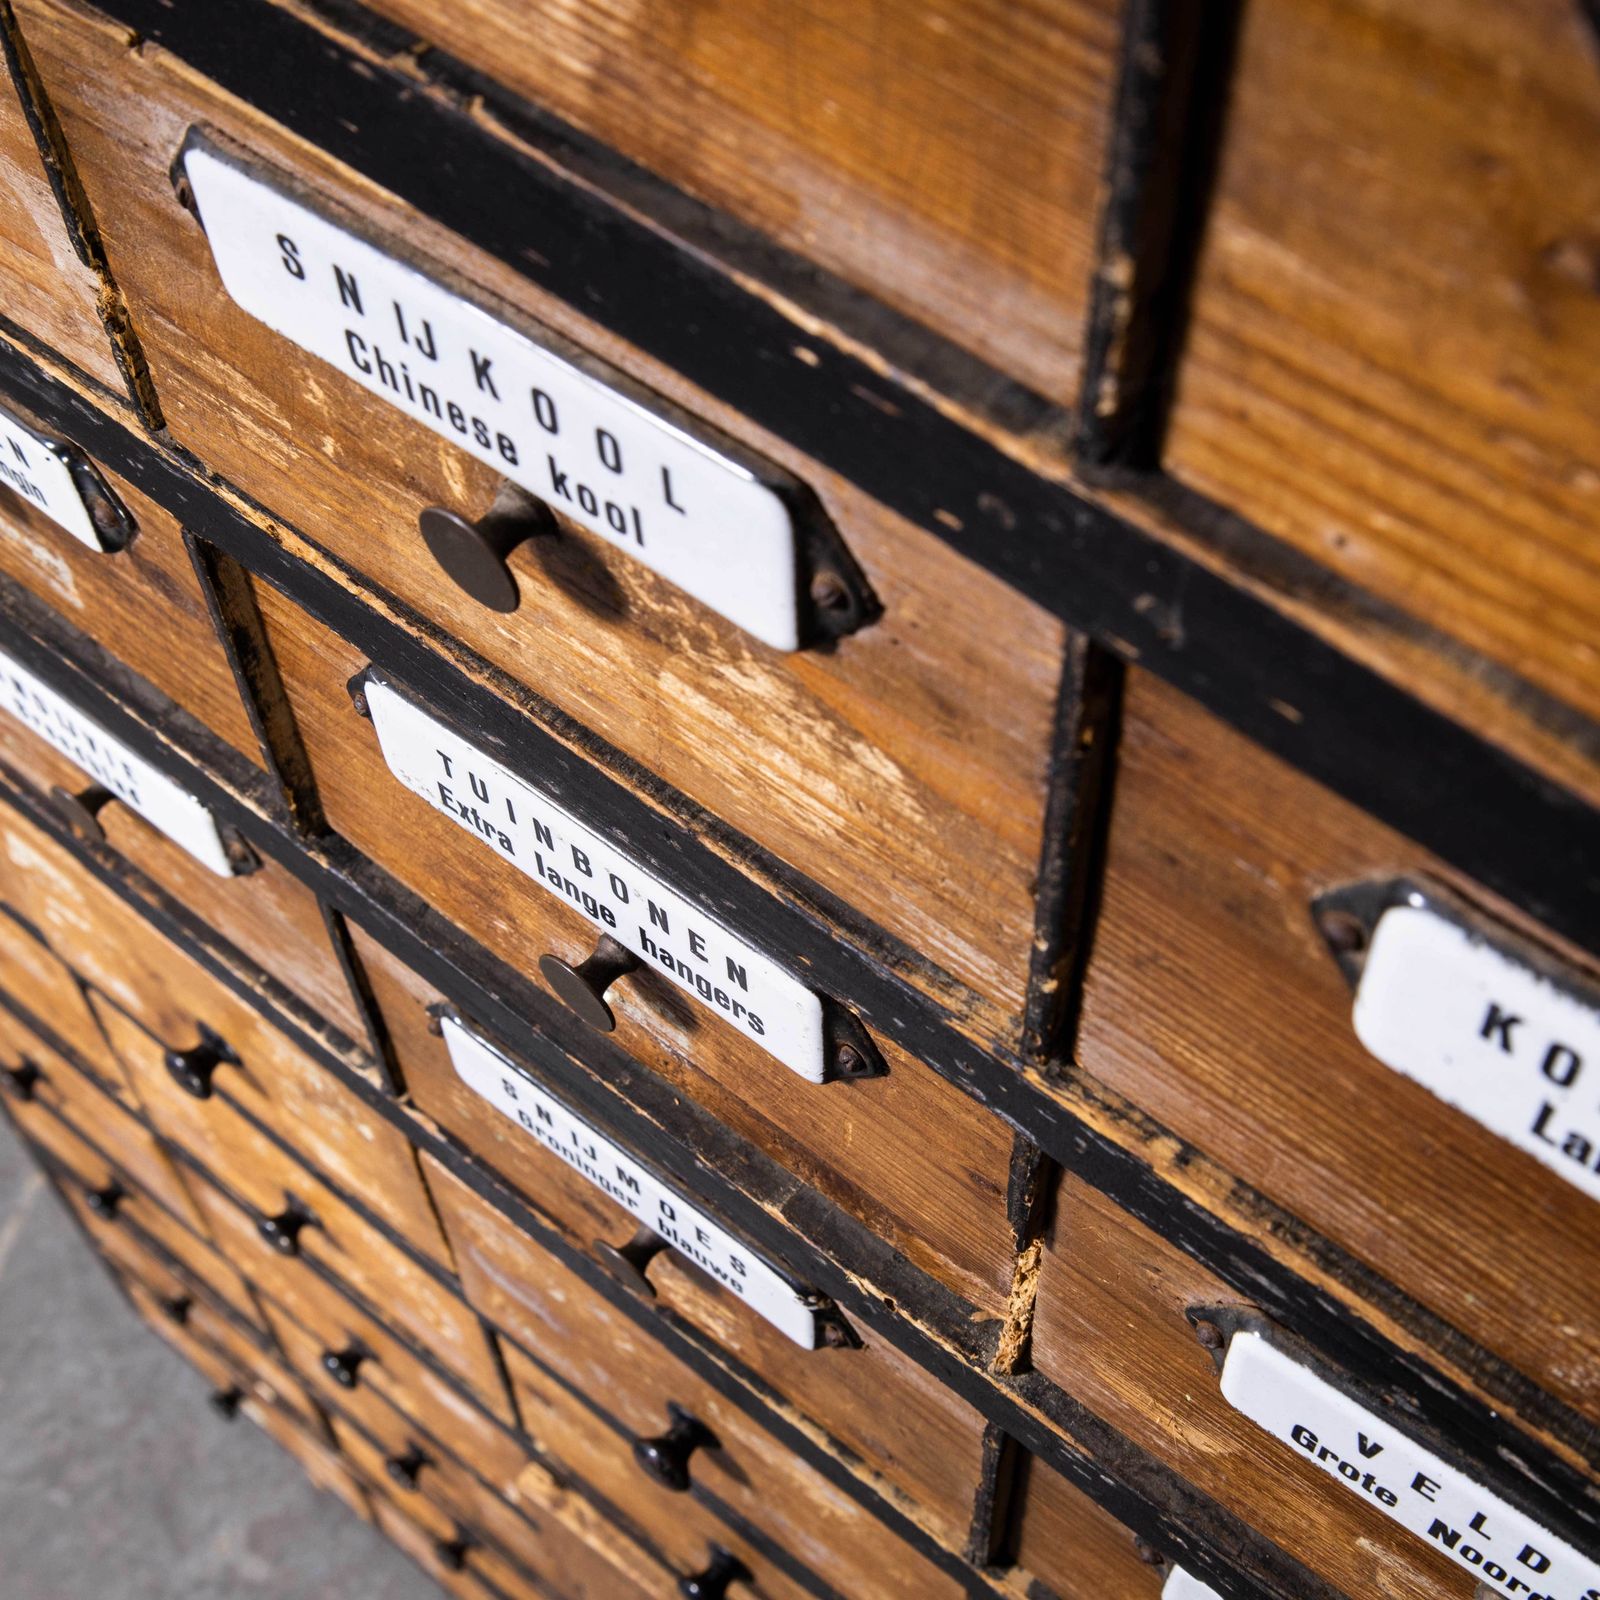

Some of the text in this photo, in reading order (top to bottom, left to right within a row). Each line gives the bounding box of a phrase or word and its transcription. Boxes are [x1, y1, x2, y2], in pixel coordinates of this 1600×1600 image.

[275, 232, 687, 515] SNIJKOOL
[344, 328, 646, 547] Chinese kool
[436, 748, 750, 993] TUINBONEN
[436, 782, 765, 1037] Extra lange hangers
[502, 1078, 747, 1278] SNIJMOES
[517, 1109, 744, 1294] Groninger blauwe
[1531, 1101, 1600, 1174] La
[1290, 1423, 1398, 1508] Grote
[1357, 1431, 1600, 1600] VELD
